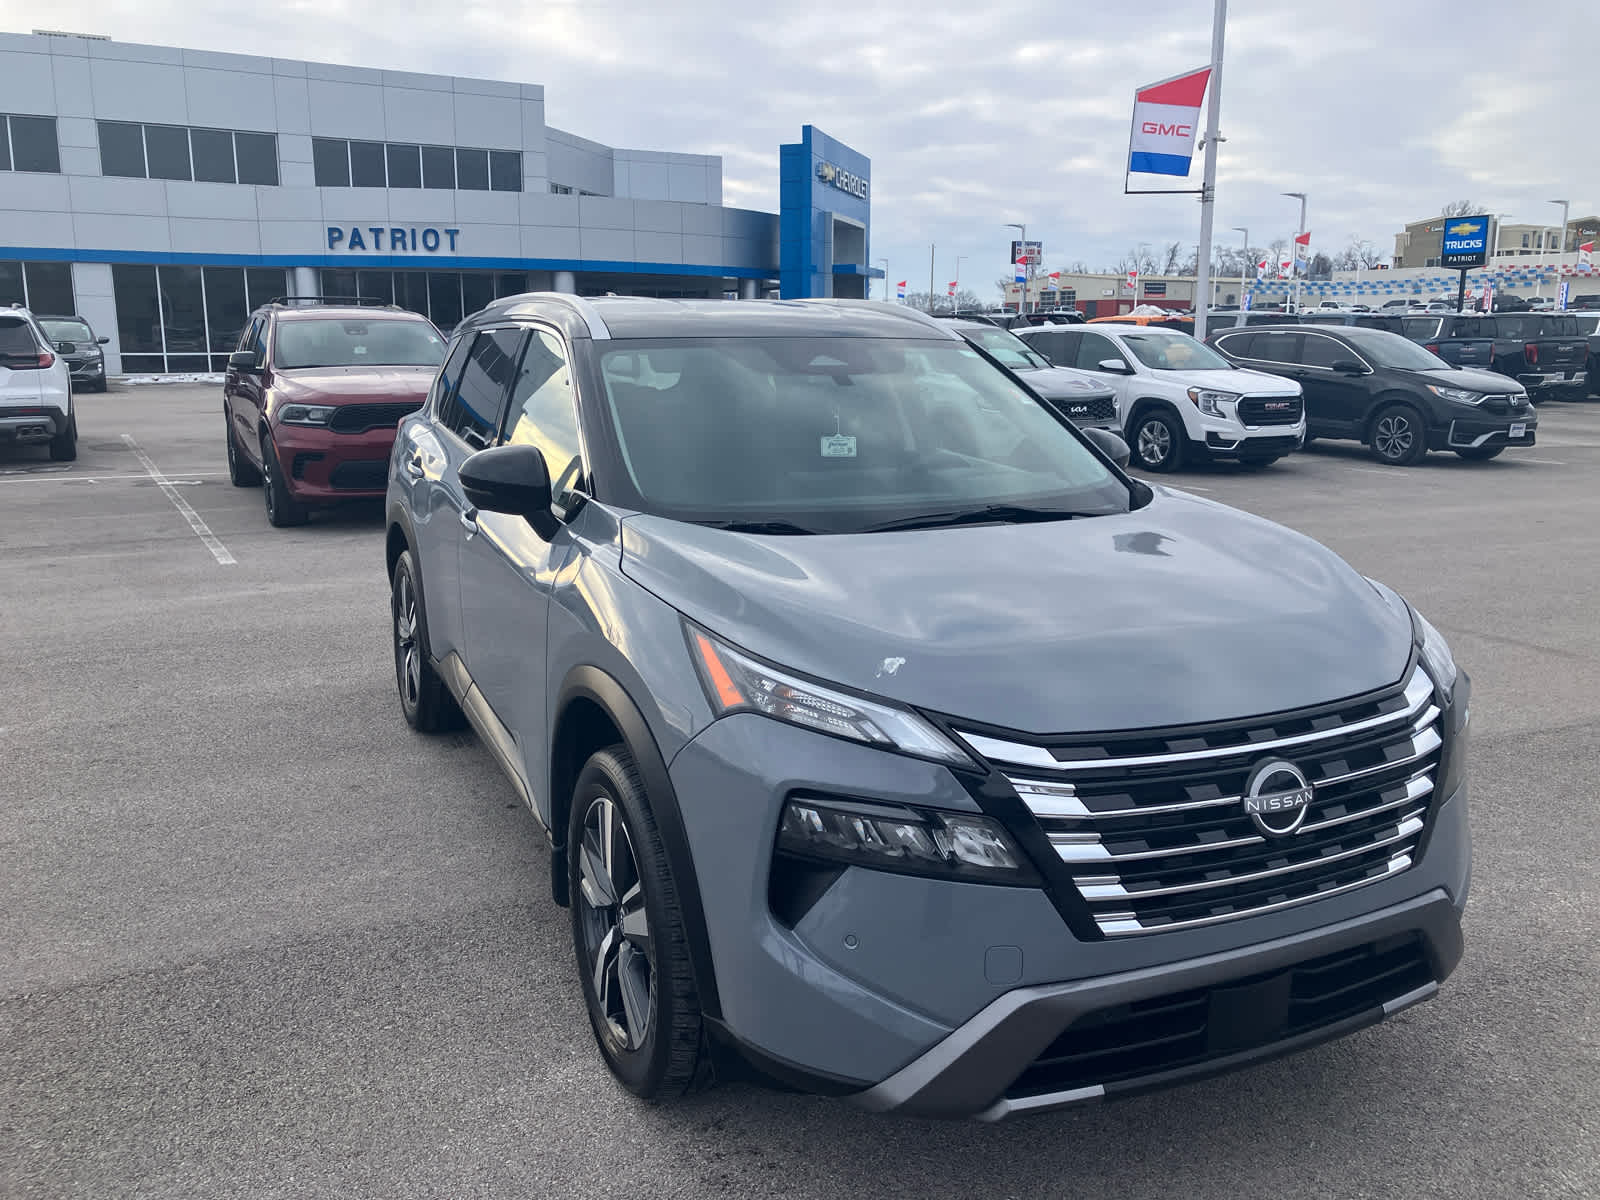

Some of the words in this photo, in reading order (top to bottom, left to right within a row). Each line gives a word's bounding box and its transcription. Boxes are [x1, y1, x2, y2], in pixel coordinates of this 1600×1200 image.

[1142, 121, 1192, 137] GMC
[835, 167, 868, 200] CHEVROLET
[327, 226, 460, 252] PATRIOT
[1445, 239, 1483, 249] TRUCKS
[1247, 789, 1313, 811] NISSAN
